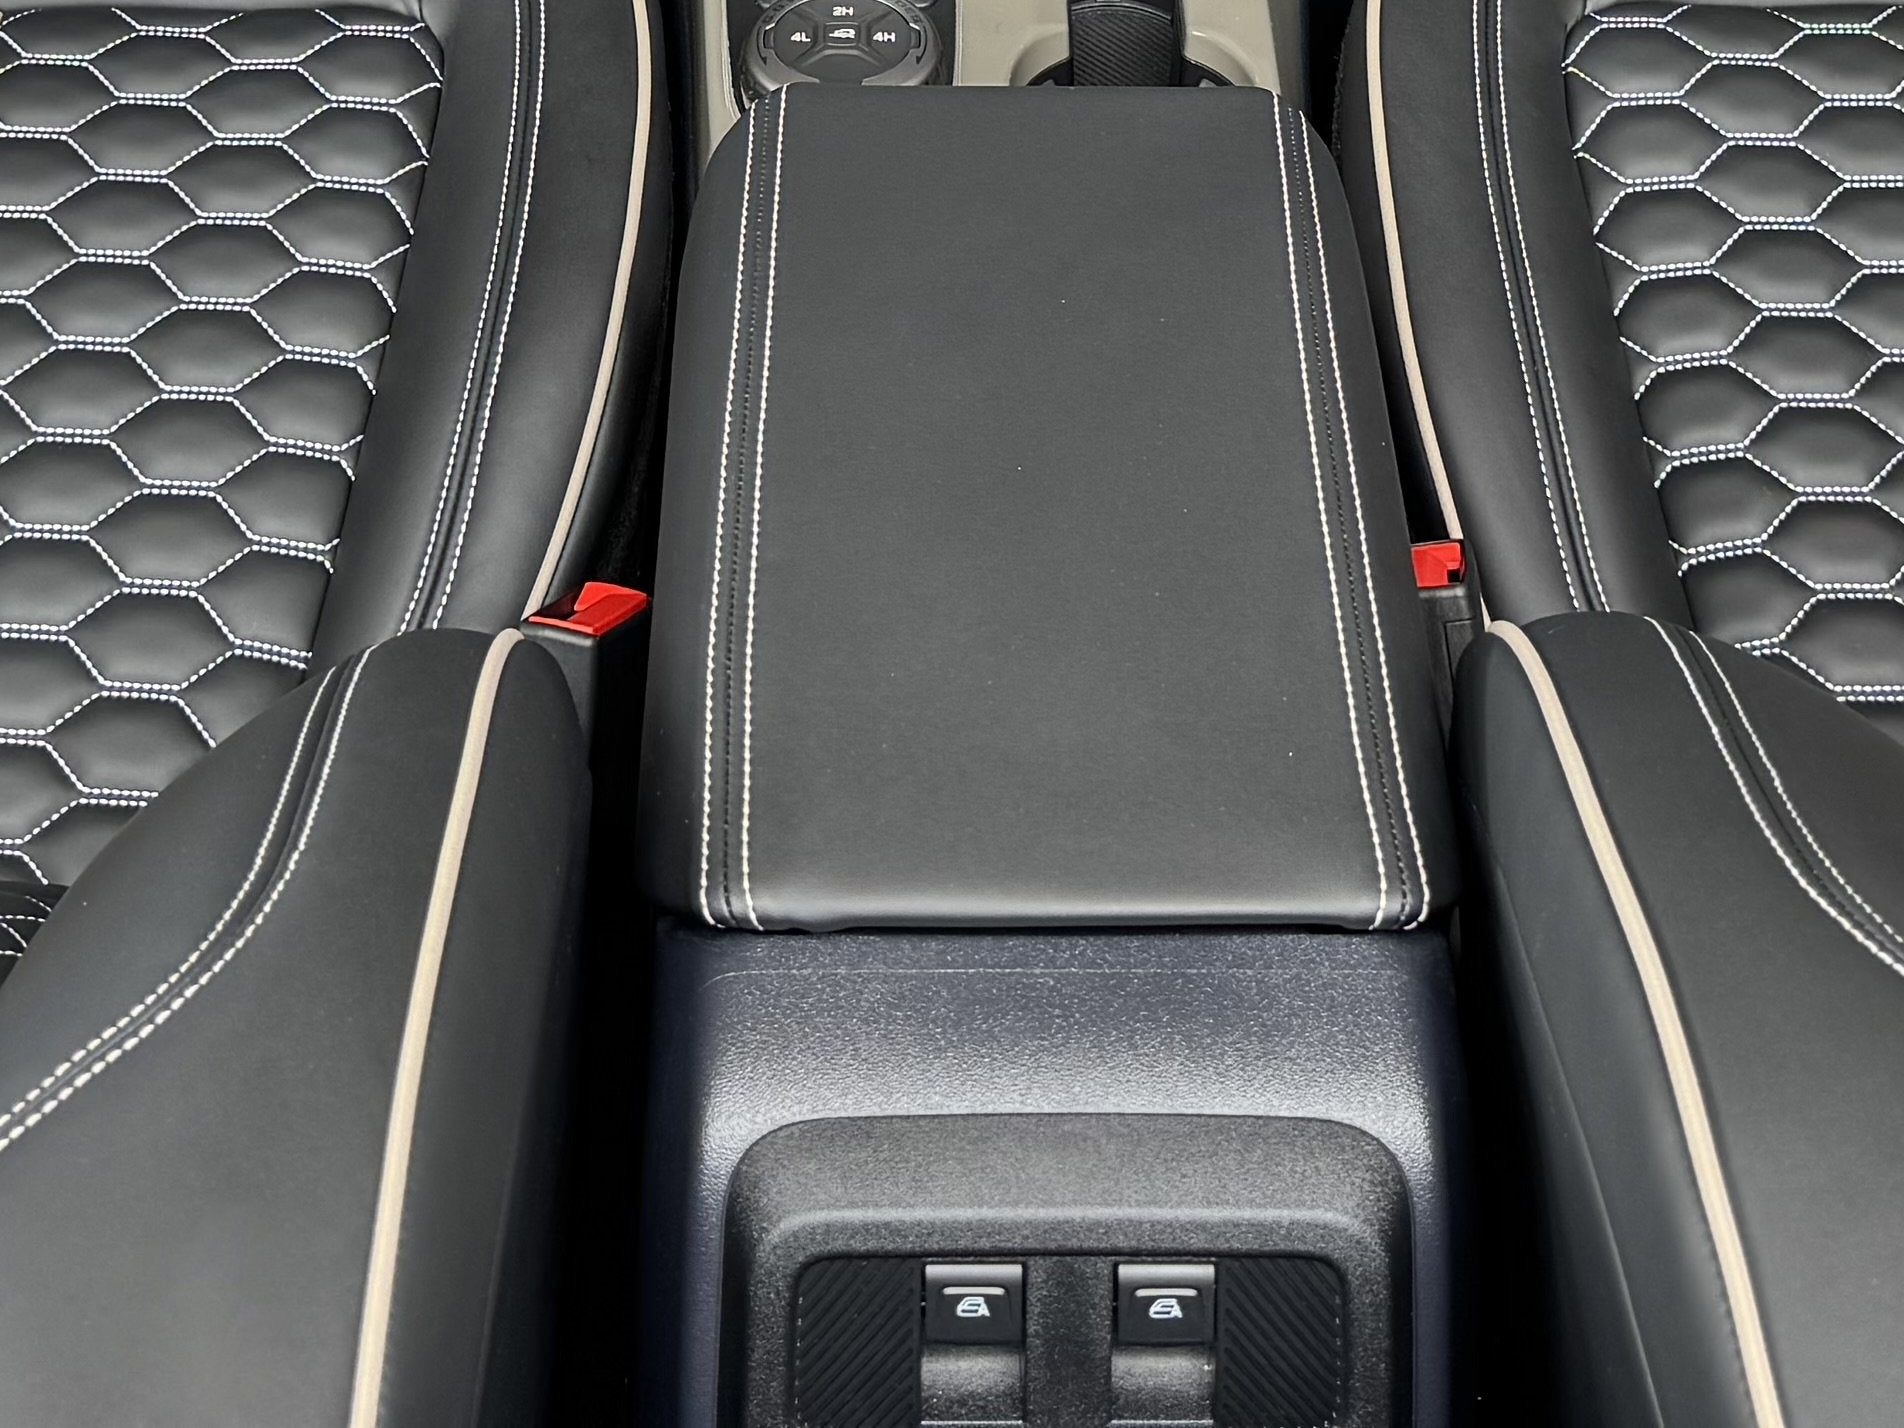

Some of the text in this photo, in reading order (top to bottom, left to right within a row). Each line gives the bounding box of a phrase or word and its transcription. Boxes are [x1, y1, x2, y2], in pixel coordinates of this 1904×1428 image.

[832, 6, 854, 16] 2H
[790, 32, 811, 42] 4L
[872, 31, 896, 43] 4H
